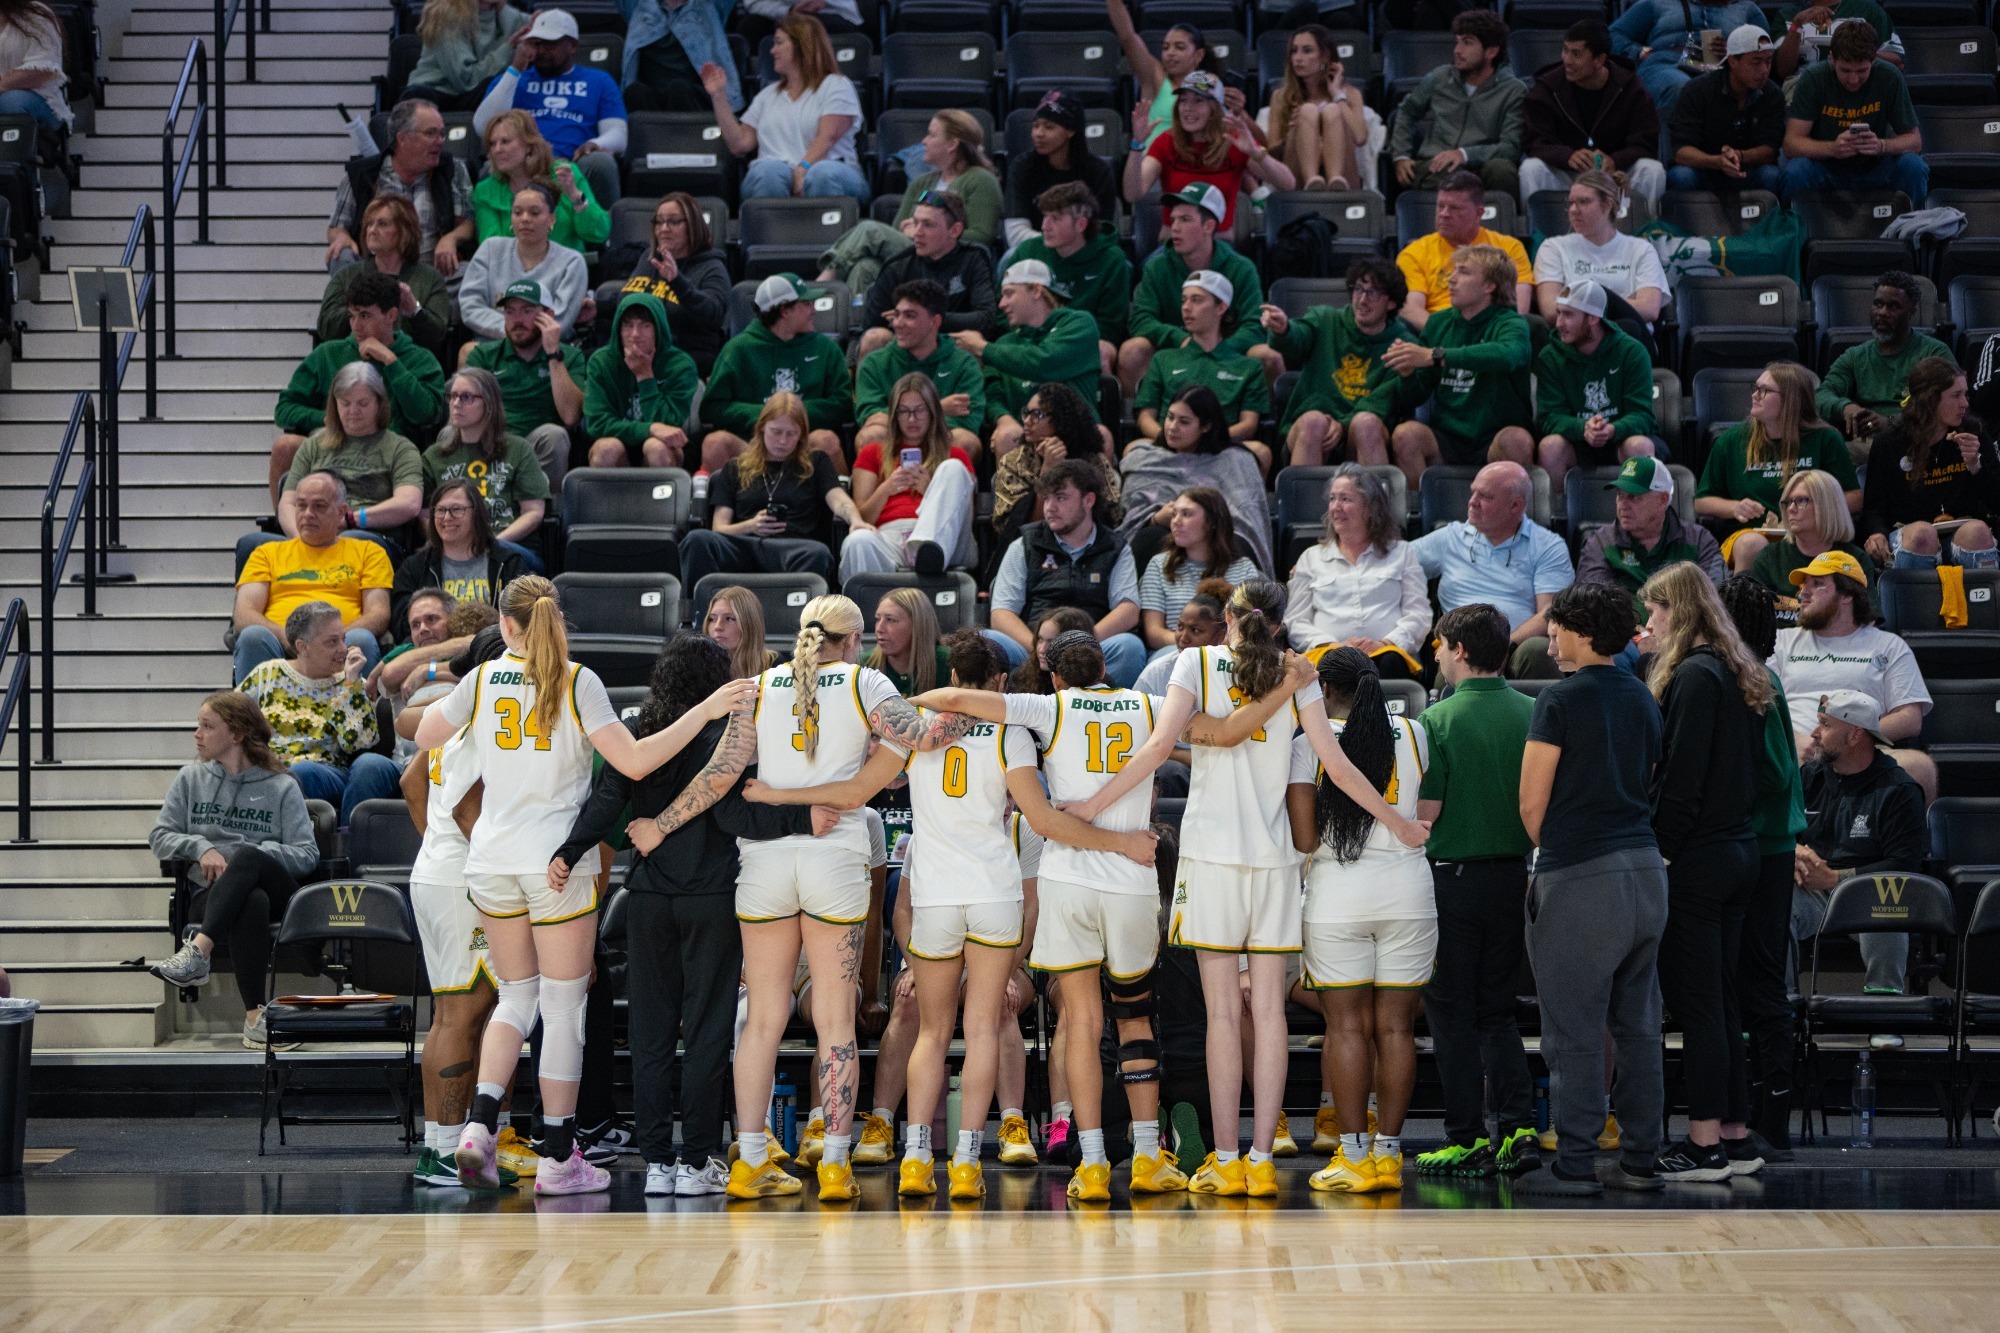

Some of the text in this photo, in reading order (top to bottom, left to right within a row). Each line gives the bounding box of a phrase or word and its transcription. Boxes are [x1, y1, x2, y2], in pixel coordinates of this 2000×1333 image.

[526, 80, 588, 97] DUKE
[1974, 591, 1985, 600] 12
[1071, 698, 1140, 712] BOBCATS
[494, 697, 552, 751] 34
[1085, 721, 1133, 773] 12
[943, 746, 967, 798] 0
[192, 802, 273, 823] LEES-McRAE
[222, 819, 273, 834] BASKETBALL
[330, 885, 367, 913] W
[1872, 876, 1909, 905] W
[830, 1050, 840, 1132] BLESSED
